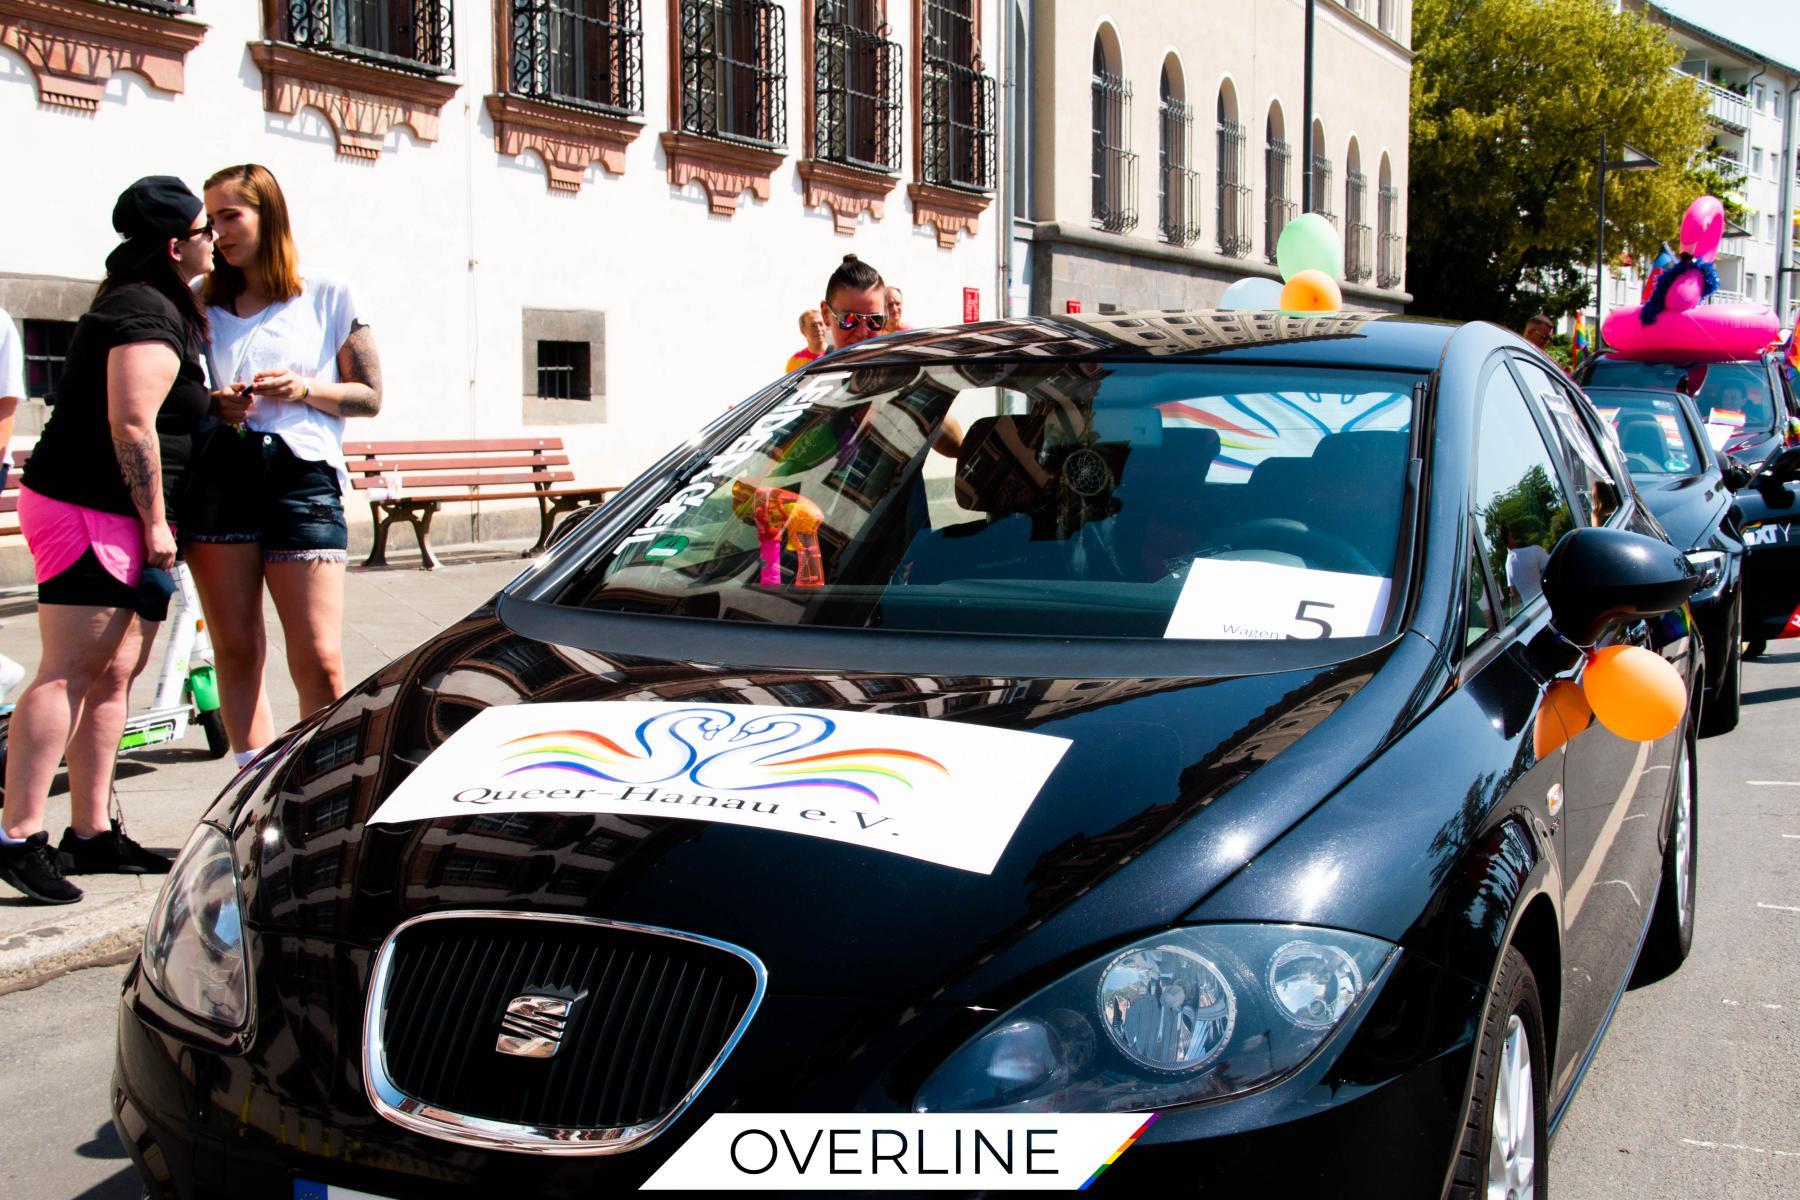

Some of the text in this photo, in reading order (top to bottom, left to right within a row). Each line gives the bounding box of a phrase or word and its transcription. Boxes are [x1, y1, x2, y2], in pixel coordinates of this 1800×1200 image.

[613, 371, 852, 556] LEIDER GEIL
[1222, 599, 1336, 640] Wagen 5
[452, 785, 780, 816] Queer-Hanau
